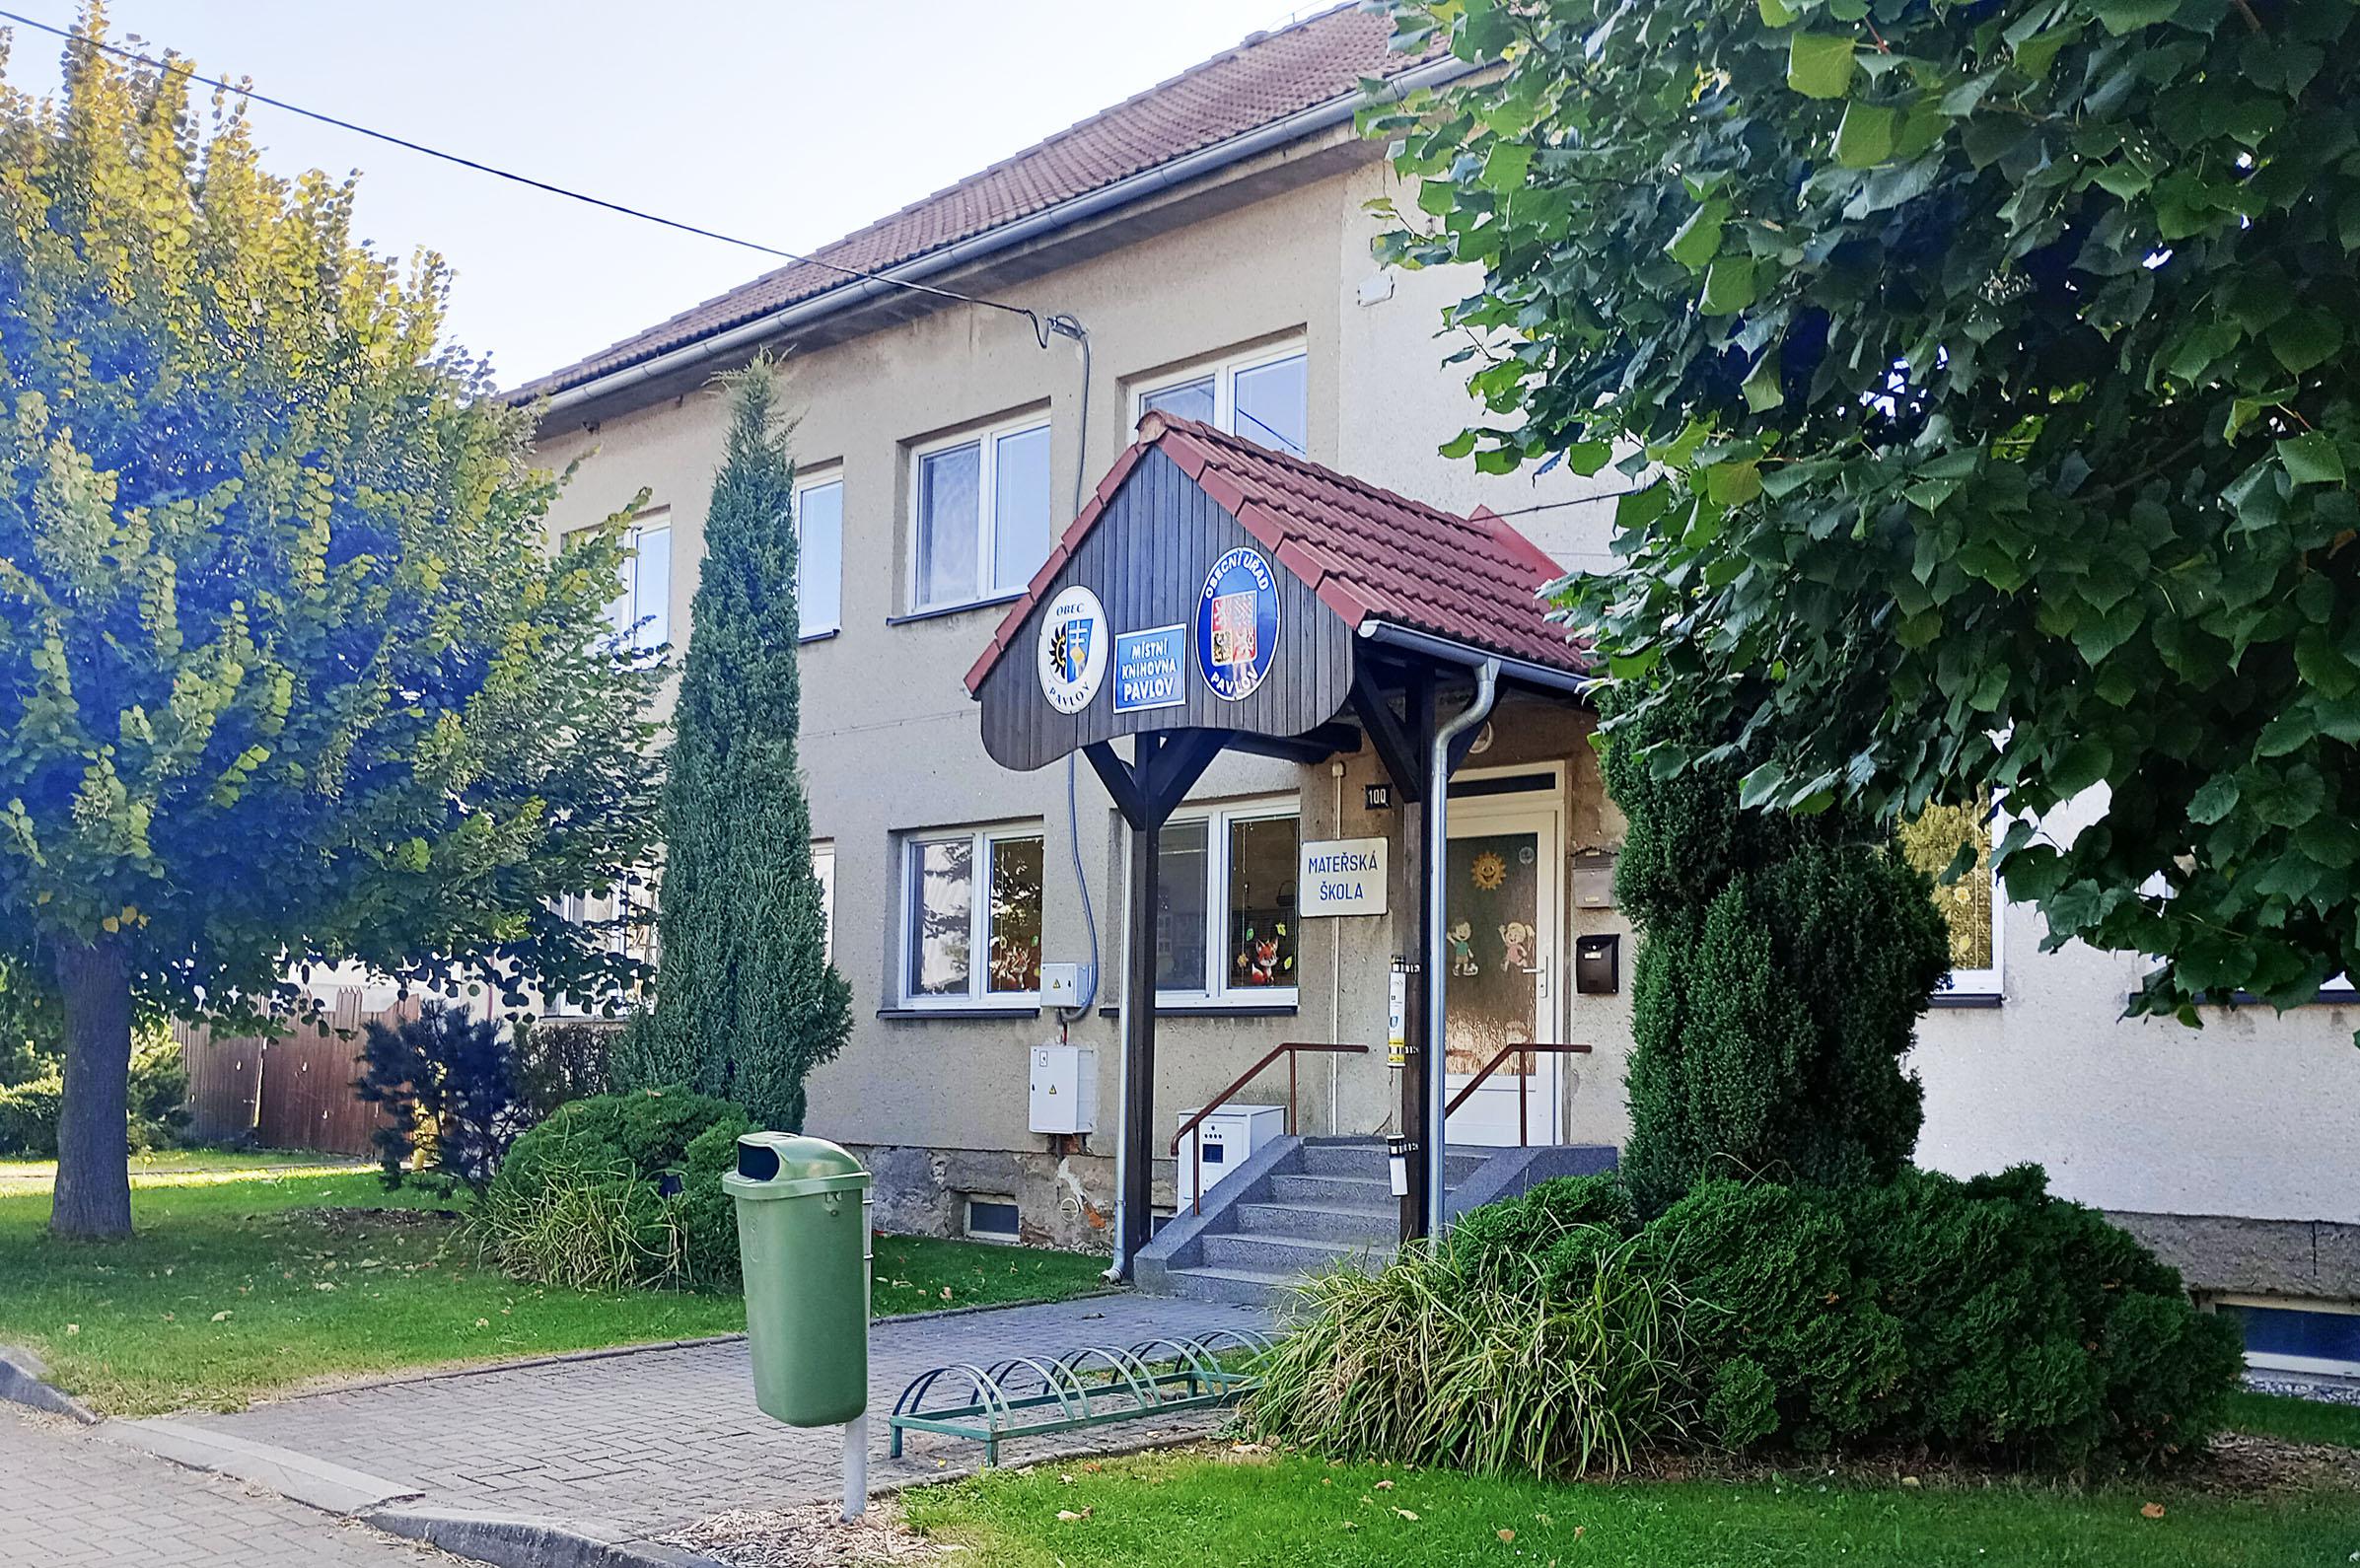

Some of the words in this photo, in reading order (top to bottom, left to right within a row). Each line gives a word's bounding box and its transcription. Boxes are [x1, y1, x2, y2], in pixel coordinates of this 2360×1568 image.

[1205, 550, 1242, 599] OBECNÍ
[1243, 552, 1269, 591] ÚŘAD
[1056, 603, 1084, 616] OBEC
[1131, 638, 1169, 660] MÍSTNÍ
[1121, 659, 1177, 680] KNIHOVNA
[1211, 668, 1258, 694] PAVLOV
[1049, 681, 1090, 706] PAVLOV
[1123, 677, 1175, 701] PAVLOV
[1368, 788, 1386, 805] 100
[1309, 850, 1378, 874] MATEŘSKÁ
[1320, 882, 1363, 900] ŠKOLA
